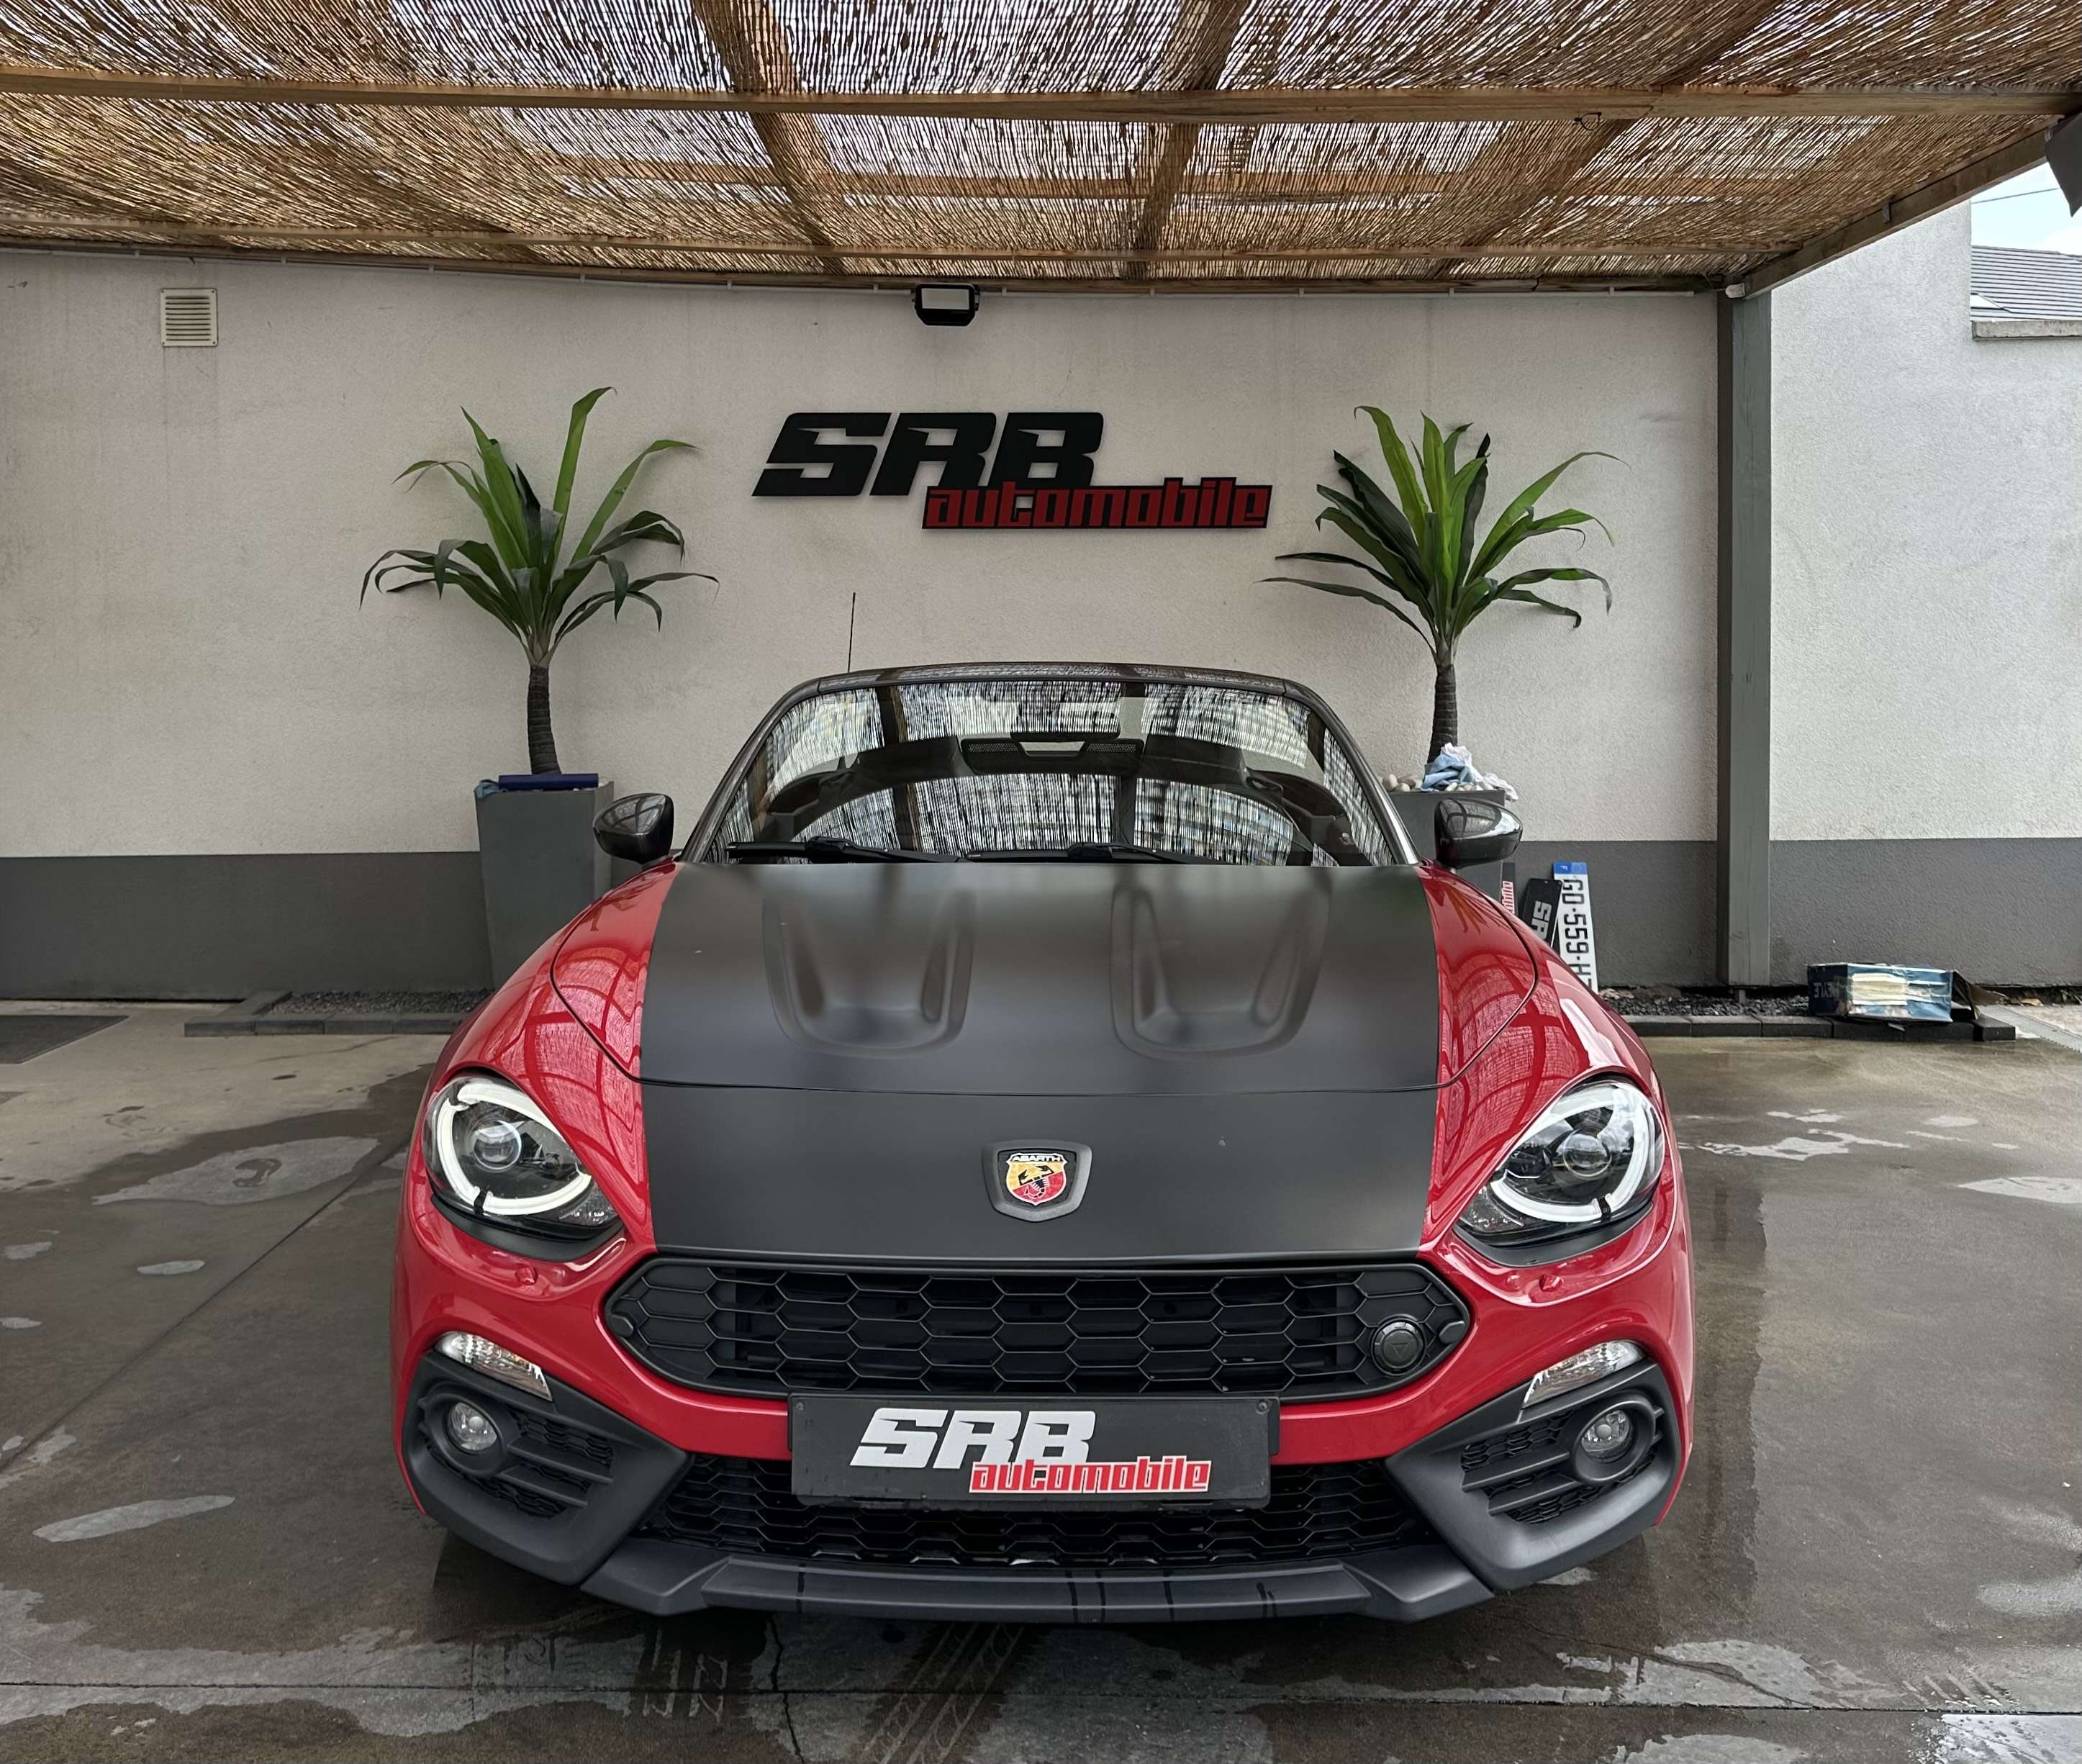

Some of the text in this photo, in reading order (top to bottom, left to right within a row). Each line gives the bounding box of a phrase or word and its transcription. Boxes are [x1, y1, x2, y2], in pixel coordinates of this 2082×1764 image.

[752, 412, 1104, 497] SRB
[922, 477, 1272, 530] automobile
[849, 1408, 1096, 1469] SRB
[969, 1455, 1212, 1493] automobile
